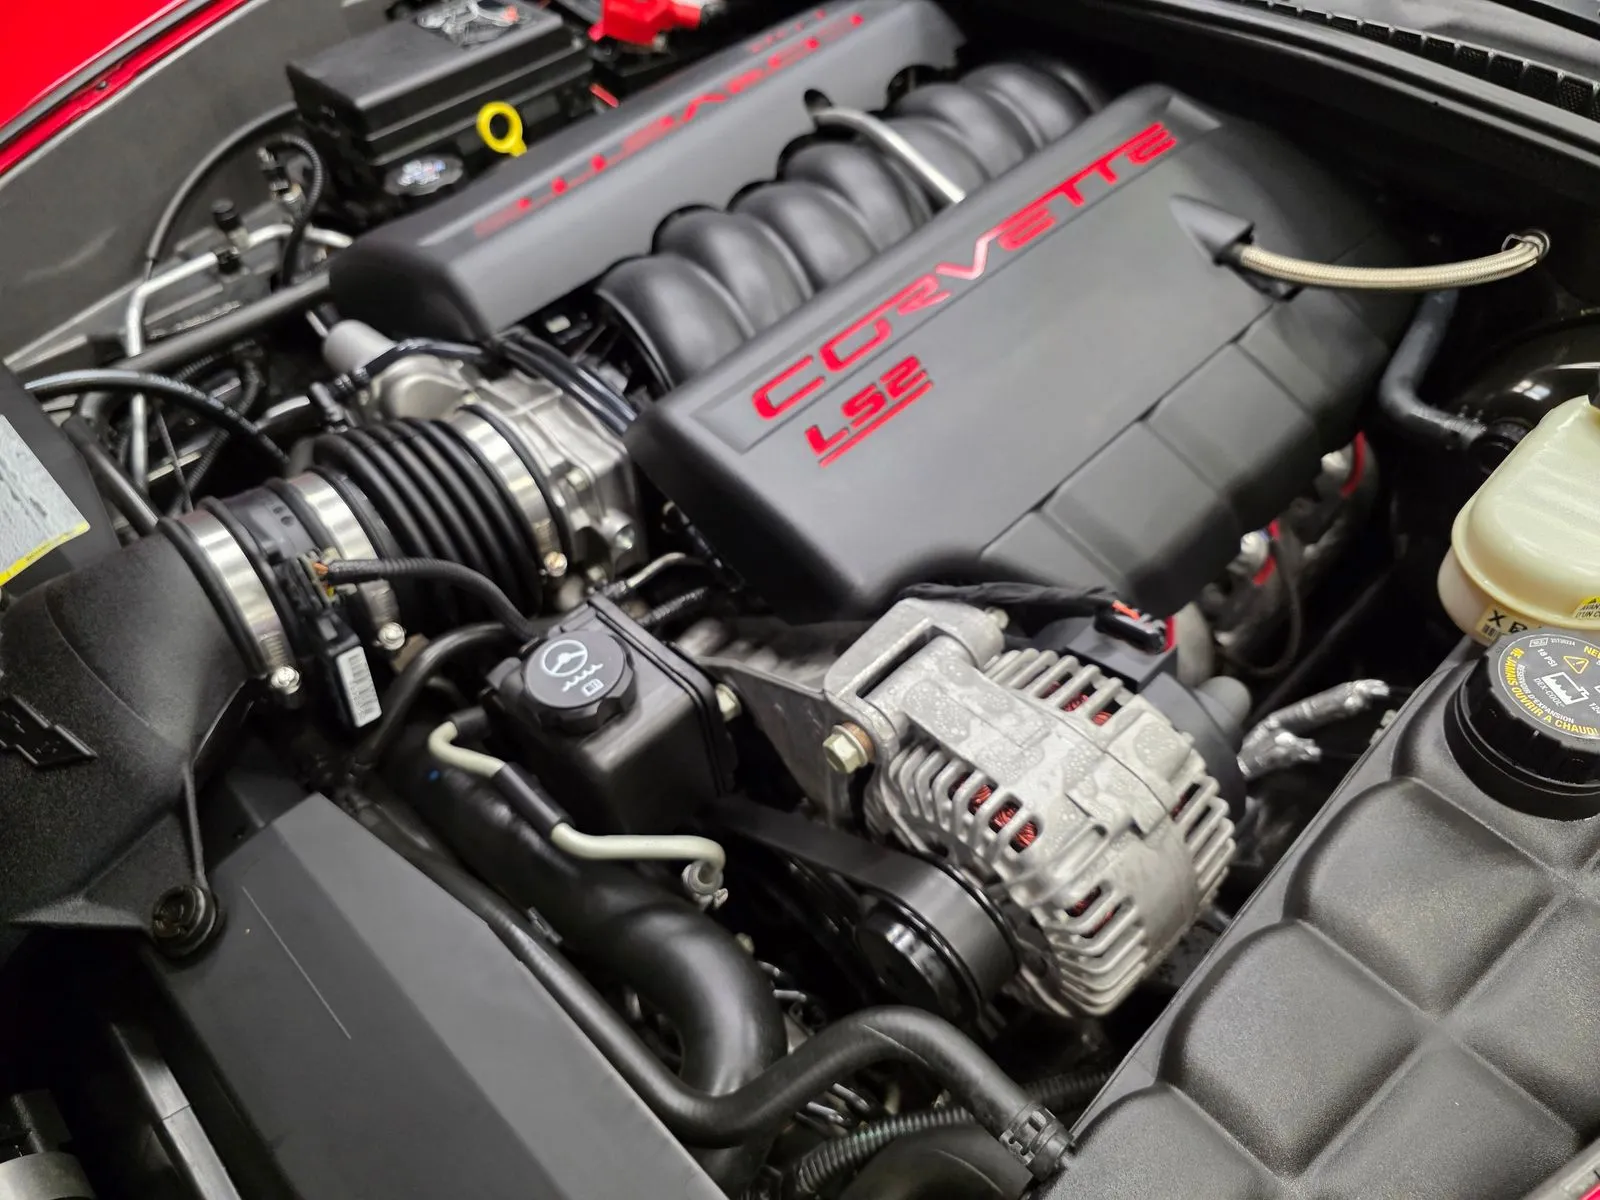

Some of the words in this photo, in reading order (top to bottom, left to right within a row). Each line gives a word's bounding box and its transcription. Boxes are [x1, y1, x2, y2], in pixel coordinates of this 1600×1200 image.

[752, 121, 1178, 420] CORVETTE
[804, 356, 930, 457] LS2
[1543, 655, 1559, 667] PSI
[1511, 686, 1544, 717] OUVRIR
